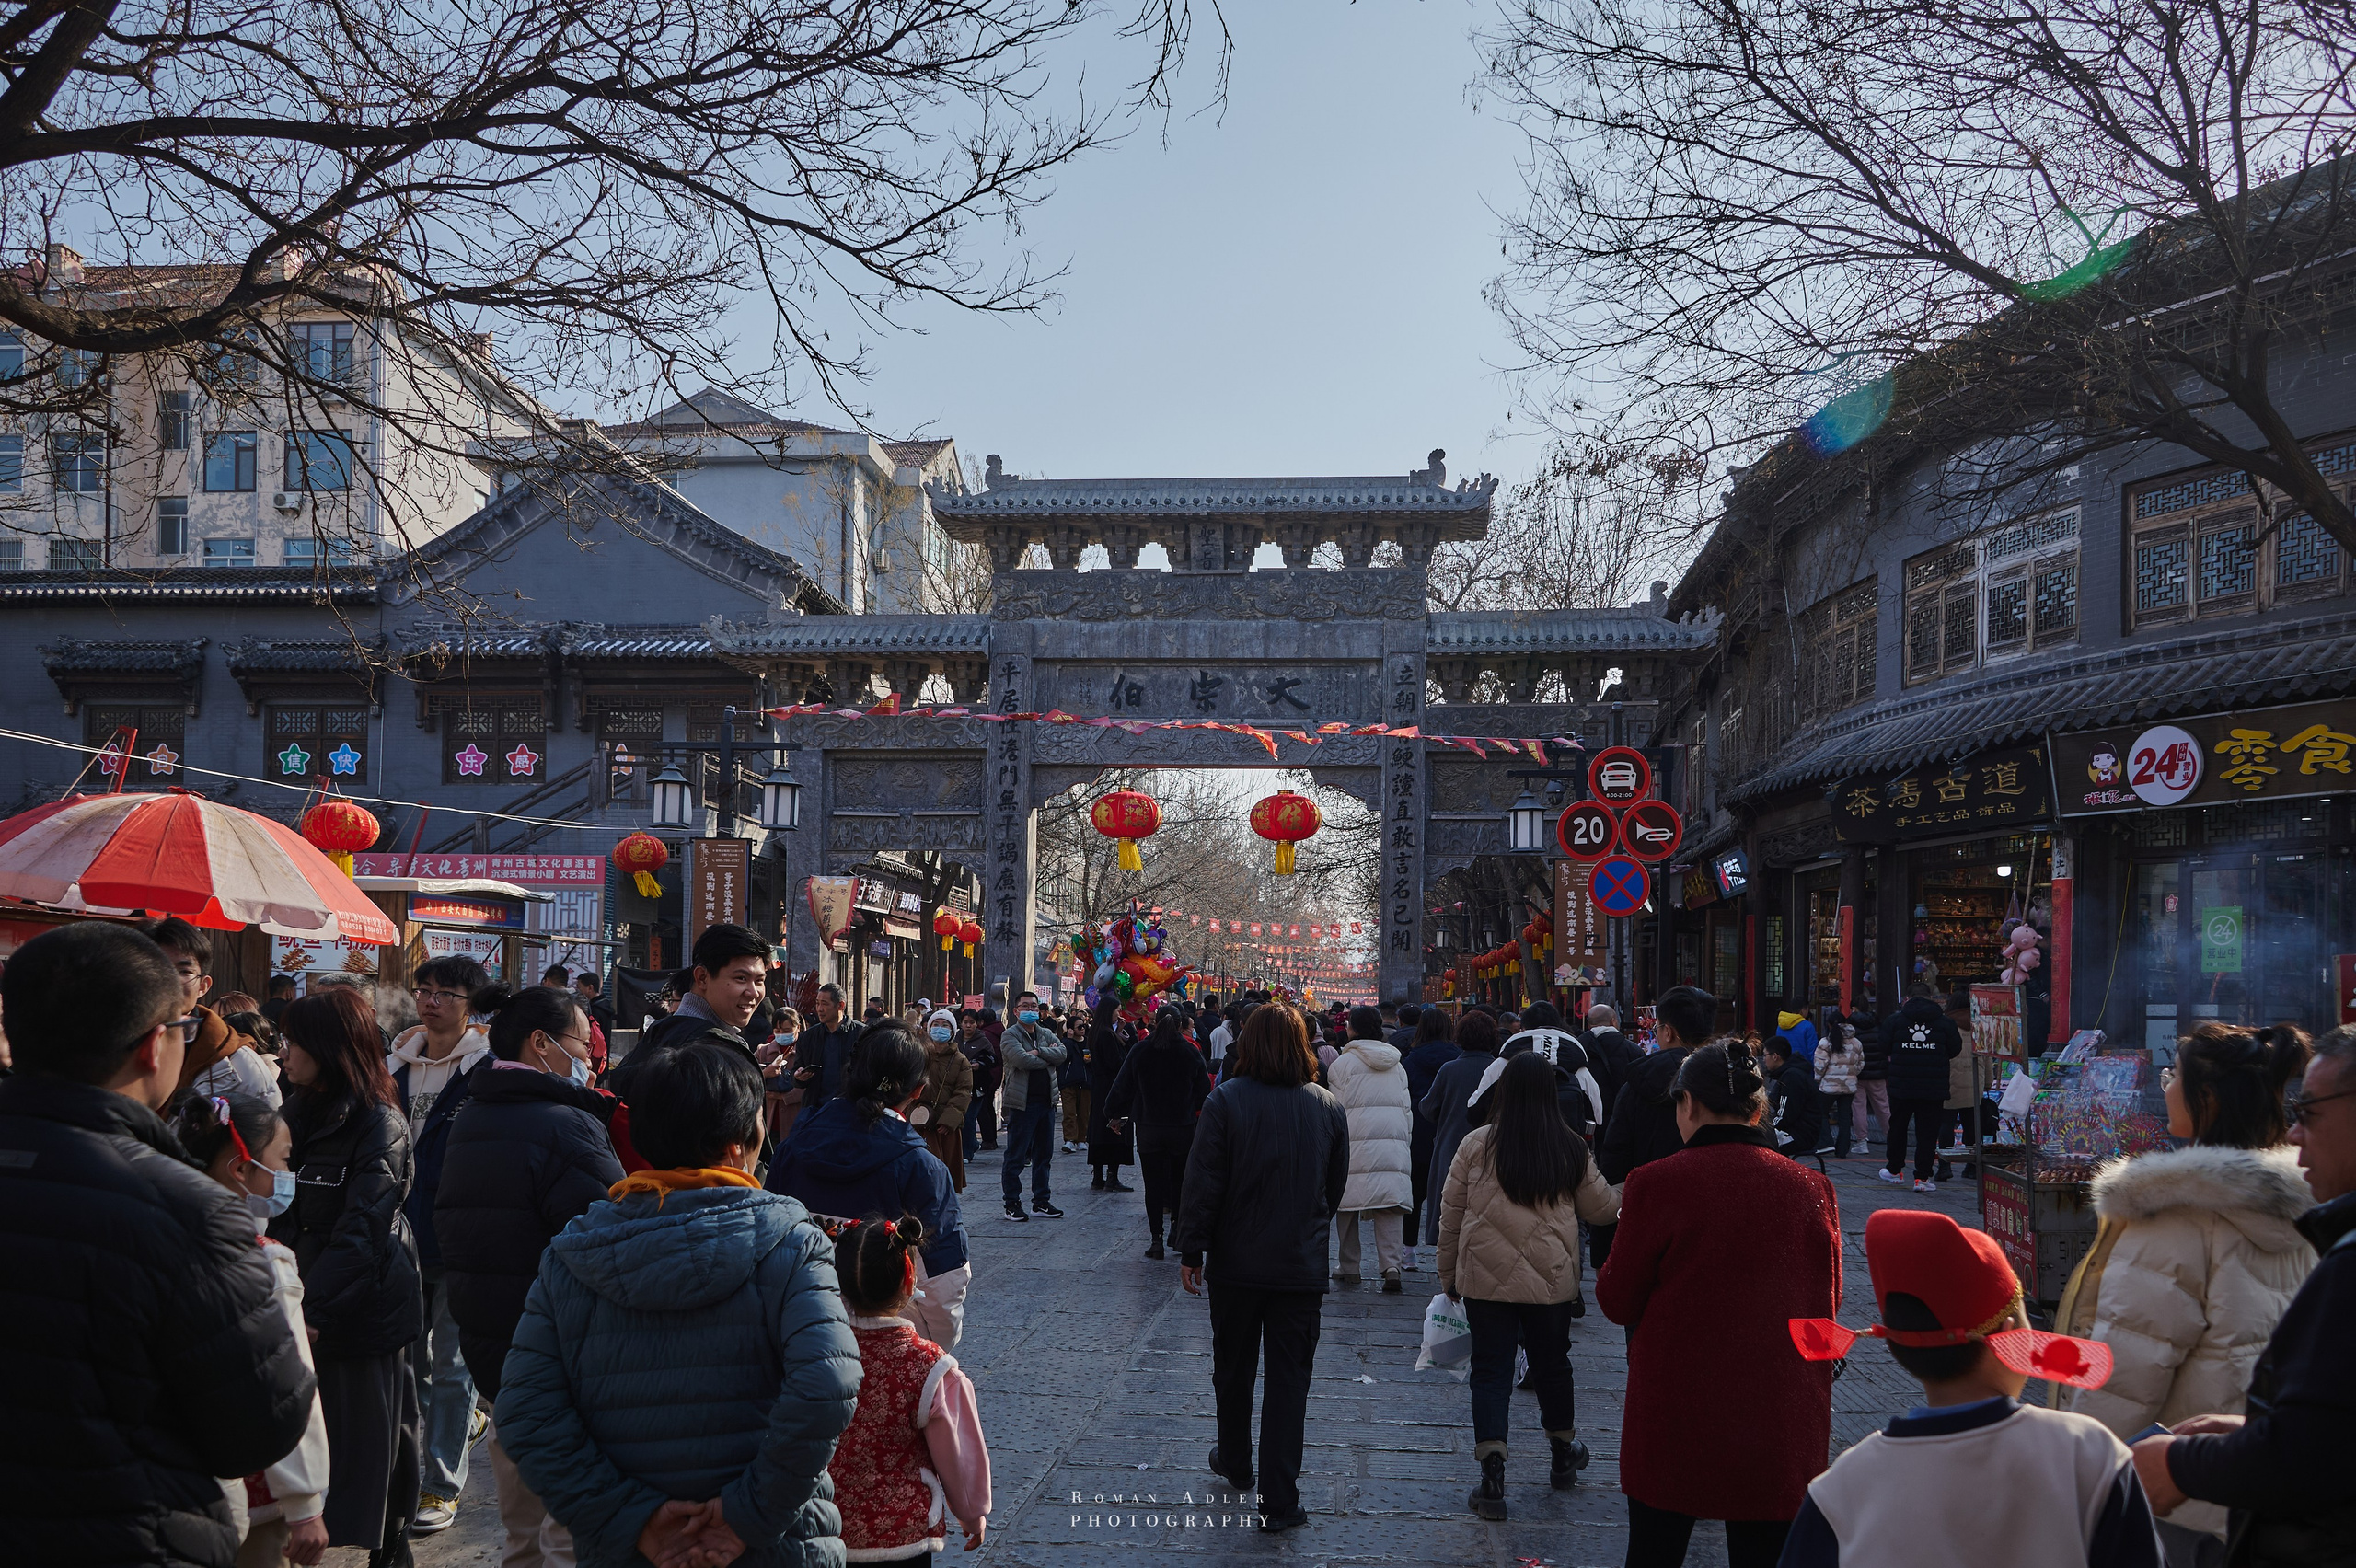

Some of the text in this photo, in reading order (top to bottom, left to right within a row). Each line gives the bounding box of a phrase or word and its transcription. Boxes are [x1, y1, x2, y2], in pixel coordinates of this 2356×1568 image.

[287, 753, 302, 769] 信
[338, 753, 353, 769] 快
[465, 754, 479, 769] 乐
[514, 754, 529, 769] 感
[2131, 744, 2181, 786] 24
[2214, 724, 2356, 791] 零食
[1894, 809, 1970, 827] 手工艺品
[1573, 816, 1605, 845] 20
[491, 858, 596, 868] 青州古城文化惠游客
[491, 869, 595, 880] 沉浸式情景小剧 文艺演出
